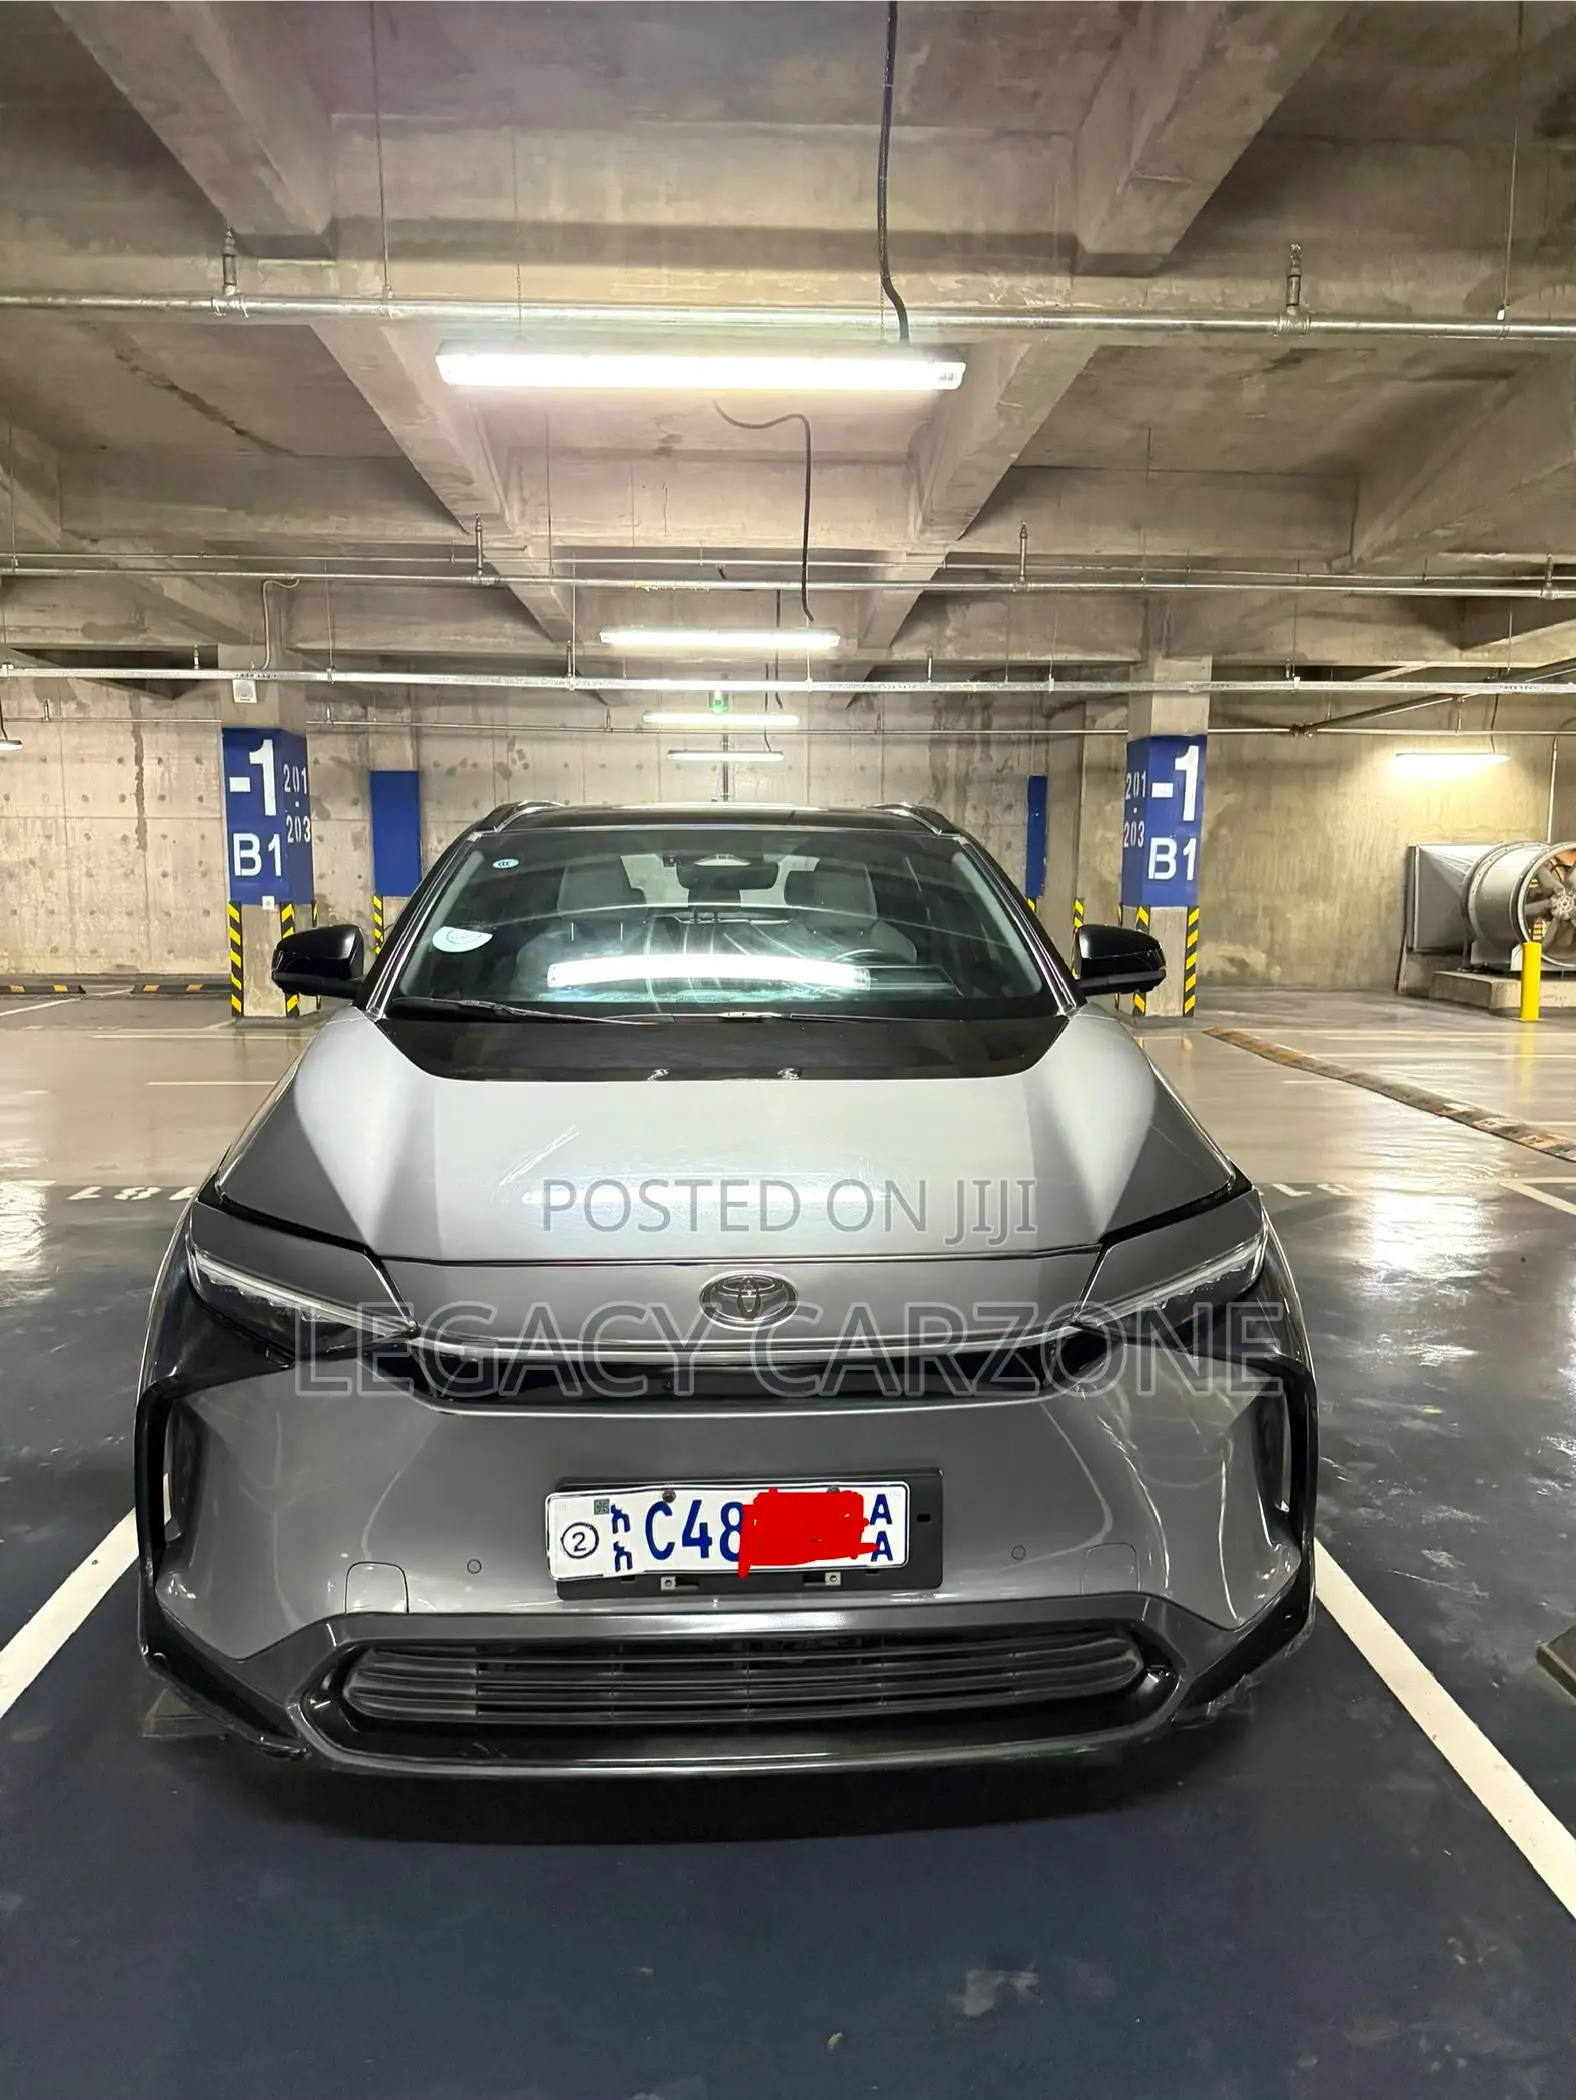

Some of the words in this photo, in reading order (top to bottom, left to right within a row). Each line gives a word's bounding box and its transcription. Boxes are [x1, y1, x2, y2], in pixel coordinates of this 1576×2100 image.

[283, 762, 308, 795] 201
[1125, 770, 1147, 800] 201
[285, 815, 311, 844] 203
[1123, 820, 1145, 848] 203
[232, 833, 282, 877] B1
[1148, 837, 1197, 880] B1
[645, 1499, 744, 1562] C48
